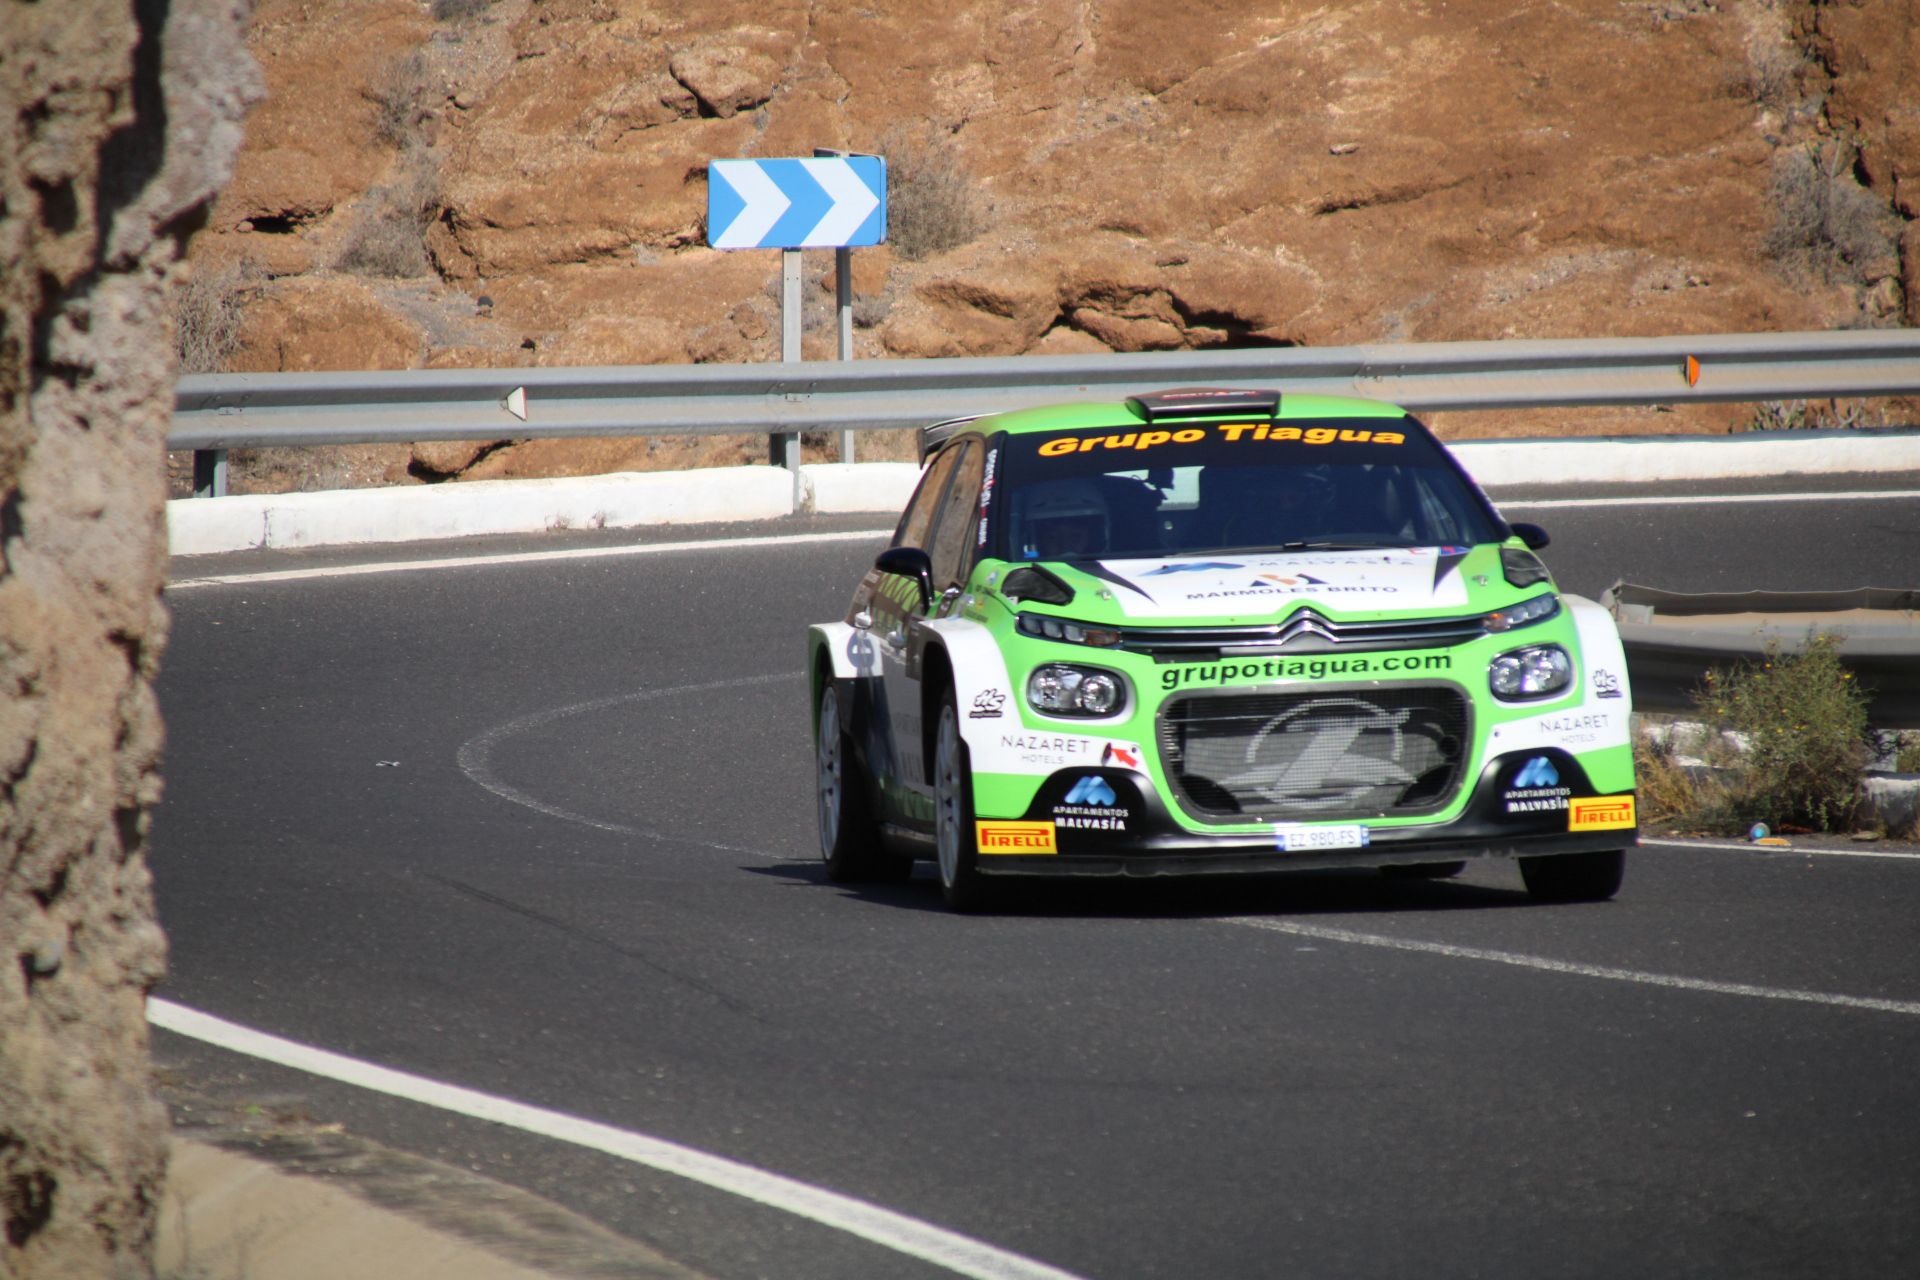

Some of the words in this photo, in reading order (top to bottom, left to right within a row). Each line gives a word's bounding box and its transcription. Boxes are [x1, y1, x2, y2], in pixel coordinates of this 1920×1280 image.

[1038, 429, 1206, 457] Grupo
[1218, 424, 1406, 445] Tiagua
[1186, 586, 1318, 600] MARMOLES
[1327, 586, 1398, 594] BRITO
[1161, 654, 1451, 690] grupotiagua.com
[1540, 714, 1609, 733] NAZARET
[1001, 735, 1091, 753] NAZARET
[1021, 754, 1065, 765] HOTELS
[1504, 787, 1572, 800] APARTAMENTOS
[1053, 805, 1129, 818] APARTAMENTOS
[1575, 803, 1632, 824] PIRELLI
[1055, 816, 1126, 831] MALVASÍA
[981, 828, 1050, 847] PIRELLI
